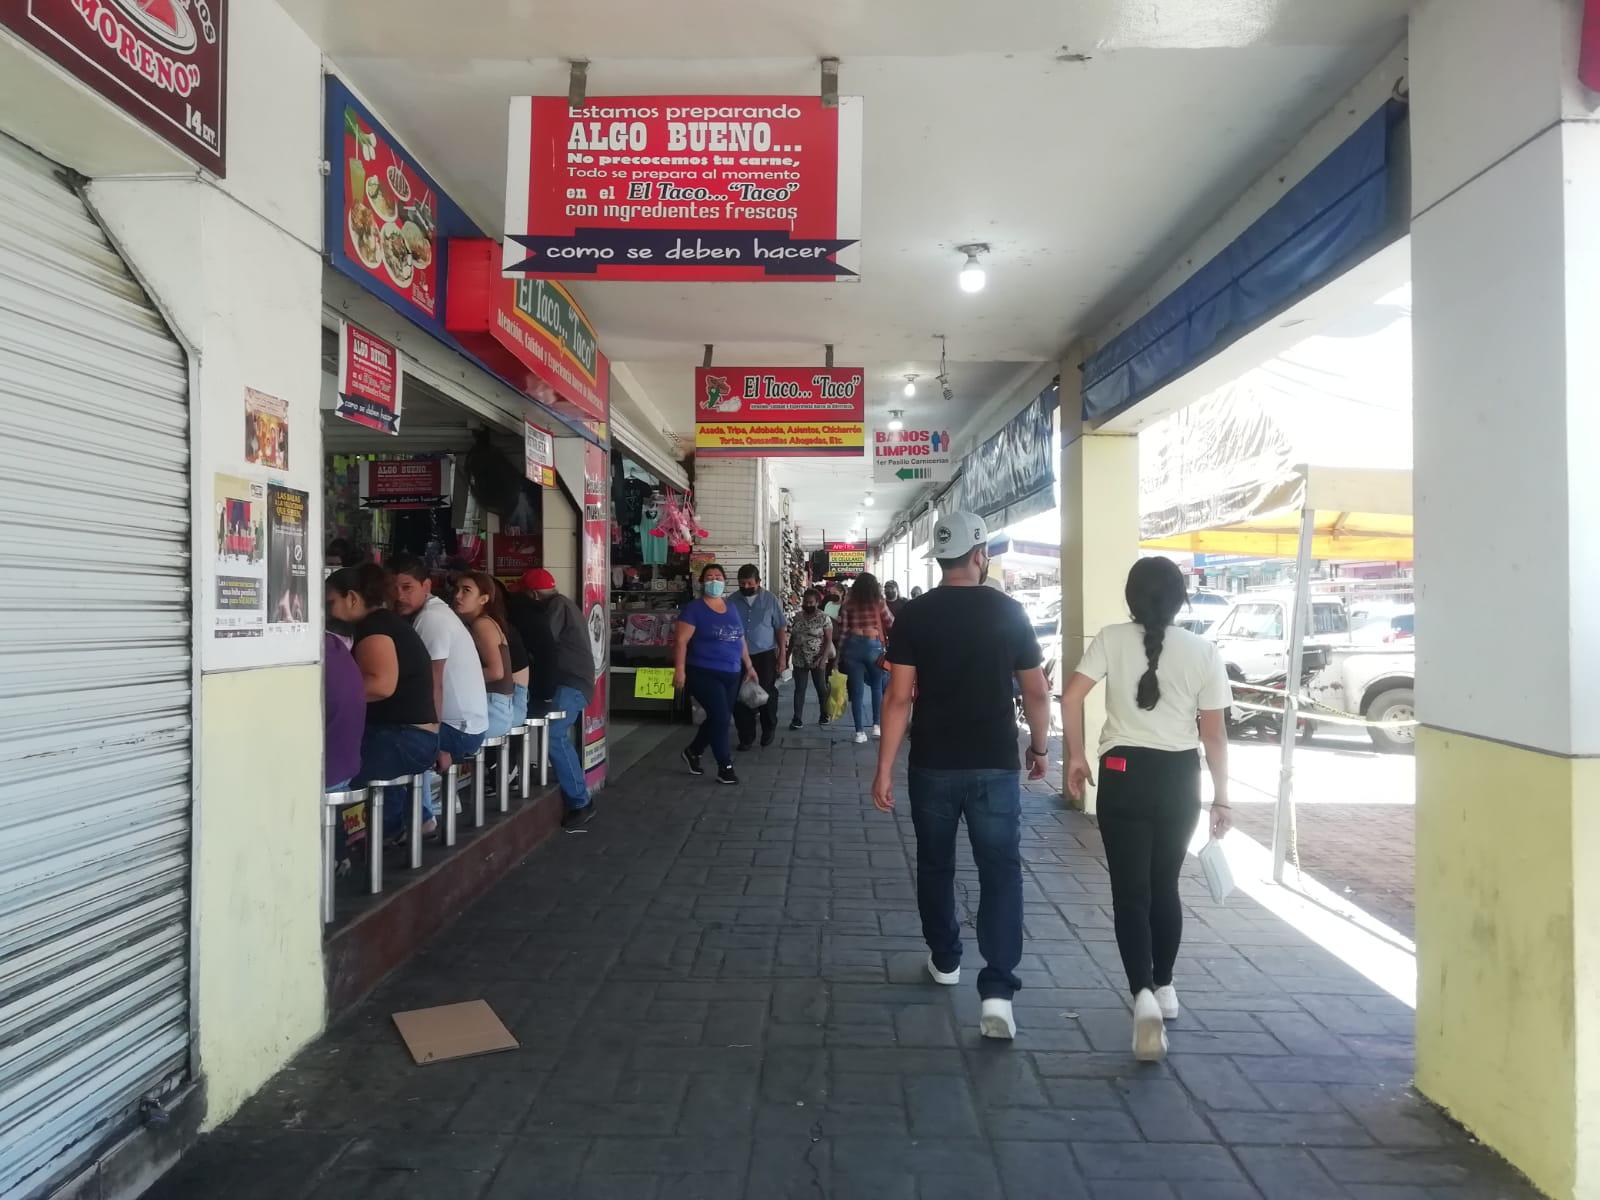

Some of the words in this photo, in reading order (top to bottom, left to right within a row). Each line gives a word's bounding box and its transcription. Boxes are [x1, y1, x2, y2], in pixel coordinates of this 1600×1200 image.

[185, 103, 202, 136] 14
[568, 105, 660, 118] Estamos
[666, 103, 802, 121] preparando
[567, 121, 648, 152] ALGO
[667, 121, 803, 152] BUENO...
[567, 152, 594, 165] No
[598, 155, 708, 166] precocemos
[713, 155, 735, 166] tu
[739, 157, 800, 168] carne,
[567, 166, 607, 178] Todo
[611, 169, 628, 178] se
[632, 170, 697, 180] prepara
[702, 168, 717, 180] al
[722, 170, 801, 180] momento
[566, 188, 587, 199] en
[599, 186, 615, 200] el
[627, 181, 654, 201] El
[655, 181, 728, 202] Taco...
[728, 181, 800, 202] "Taco"
[565, 203, 598, 217] con
[603, 201, 720, 222] ingredientes
[725, 201, 798, 219] frescos
[546, 246, 614, 259] como
[626, 248, 653, 259] se
[665, 237, 741, 260] deben
[753, 237, 827, 260] hacer
[518, 279, 533, 313] El
[743, 375, 761, 398] El
[763, 375, 812, 398] Taco...
[812, 375, 861, 399] "Taco"
[875, 444, 930, 457] LIMPIOS
